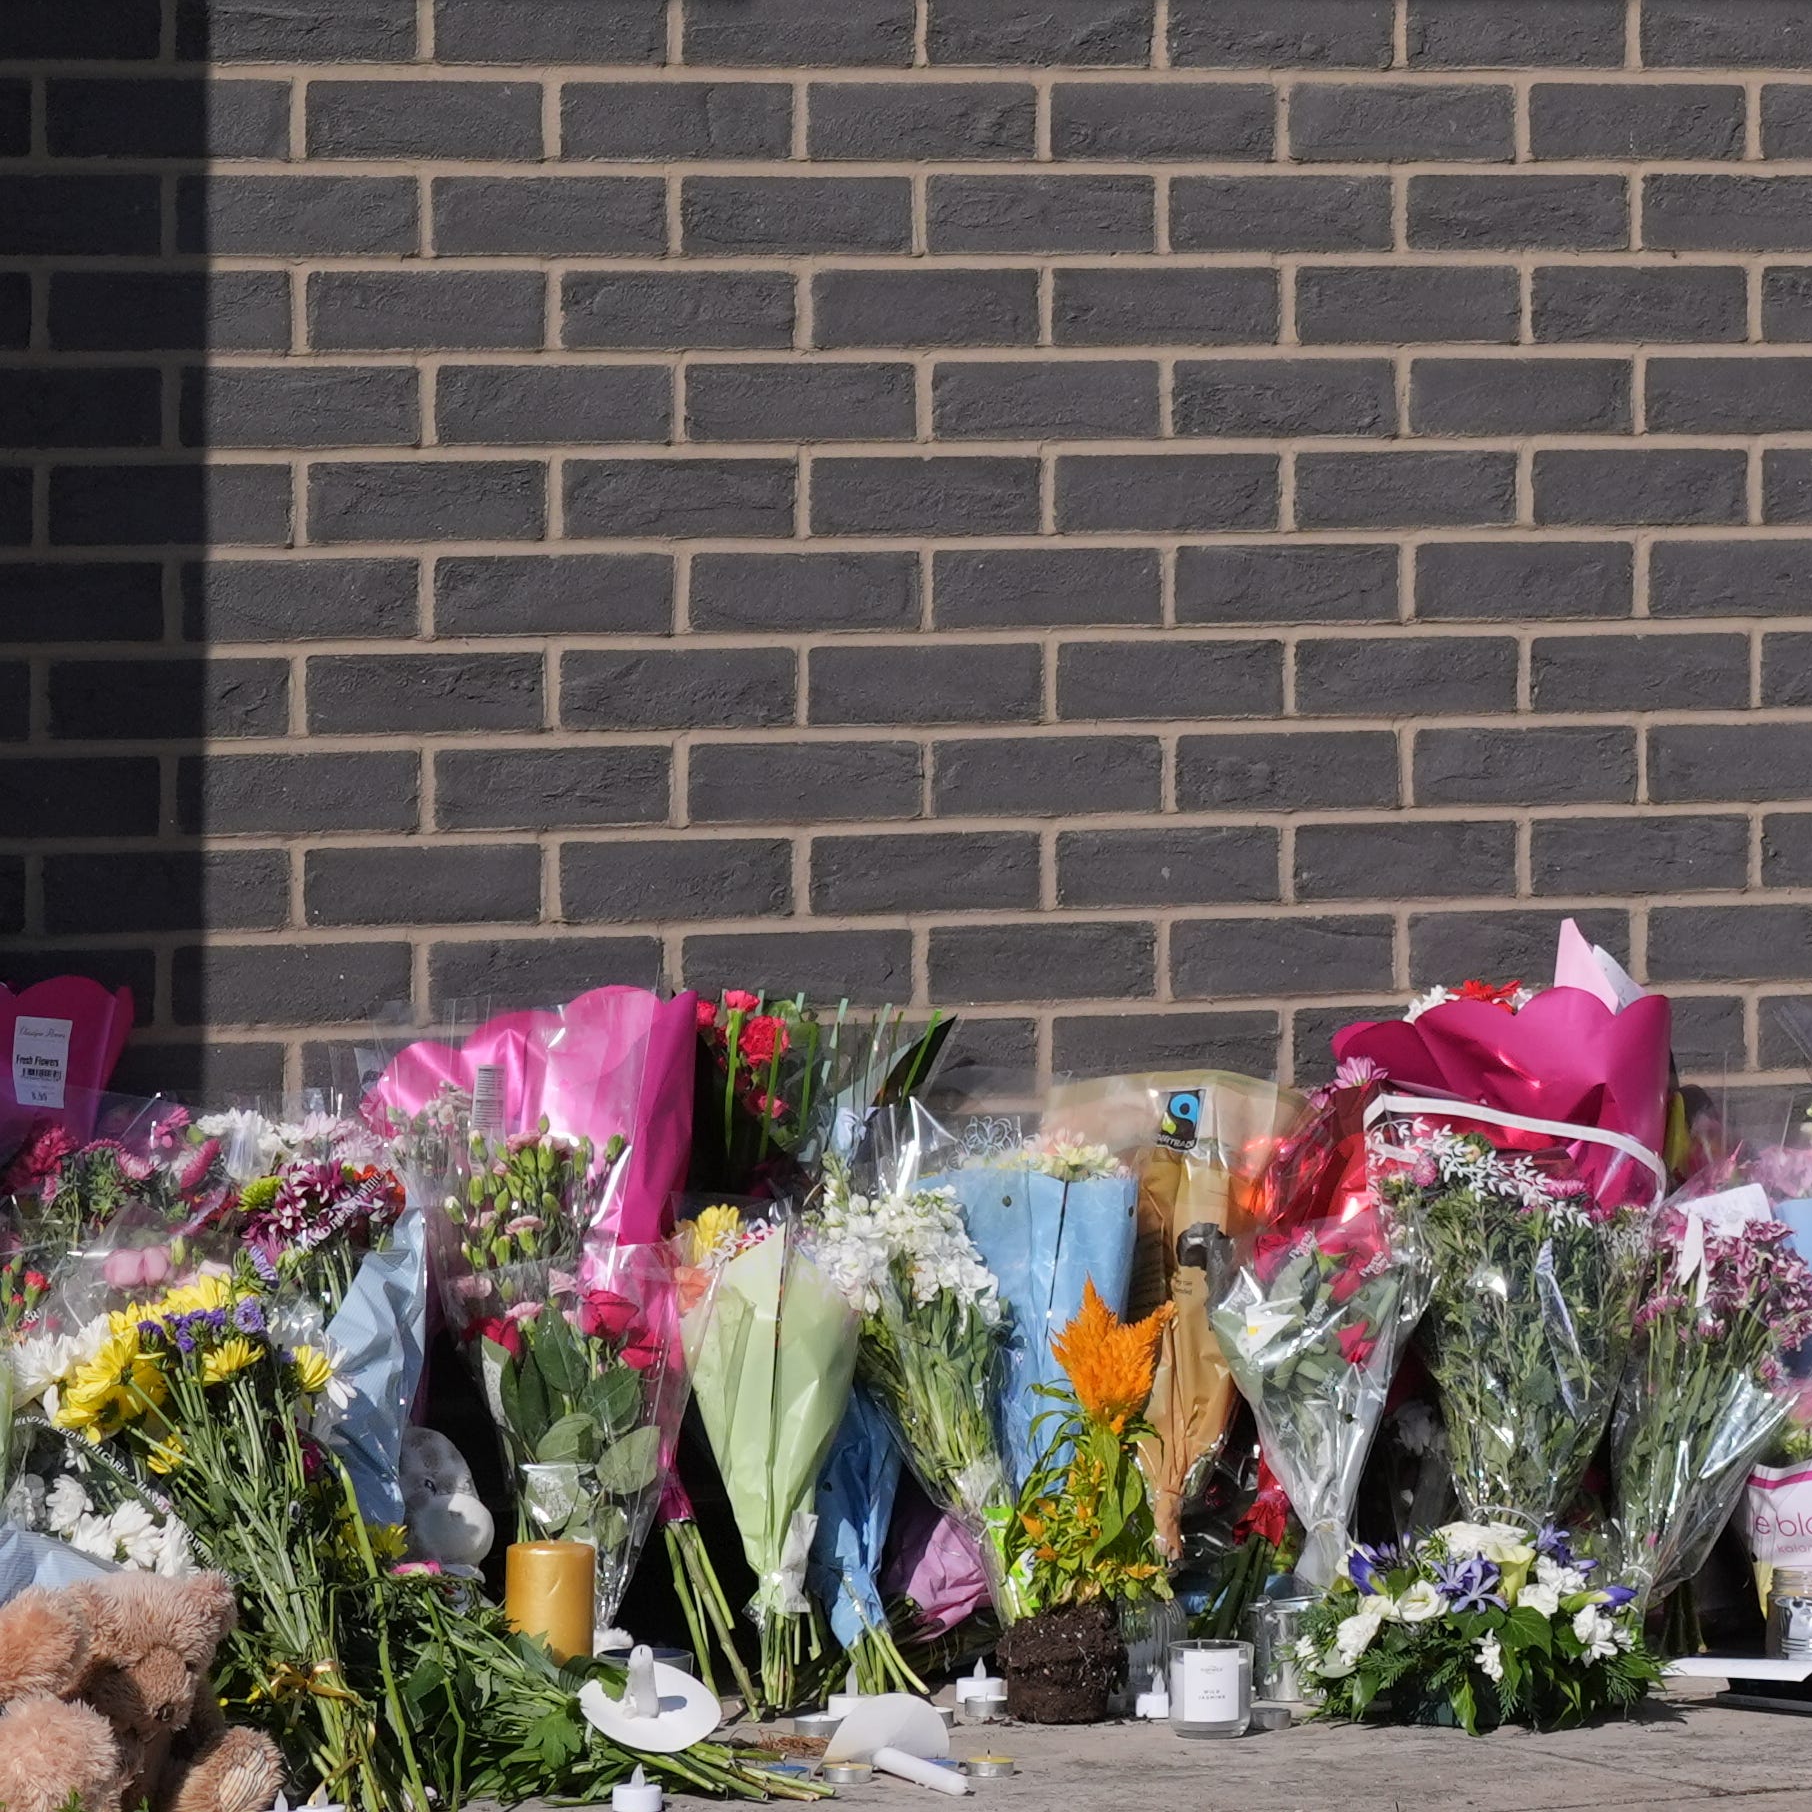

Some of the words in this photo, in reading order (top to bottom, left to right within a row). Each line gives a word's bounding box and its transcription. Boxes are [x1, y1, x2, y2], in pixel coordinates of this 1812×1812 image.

[16, 1054, 33, 1065] Fresh
[34, 1056, 59, 1067] Flowers
[1152, 1133, 1195, 1148] AIRTRAD
[38, 1418, 76, 1439] PIKED
[76, 1434, 104, 1454] WIH
[100, 1450, 129, 1477] CARE
